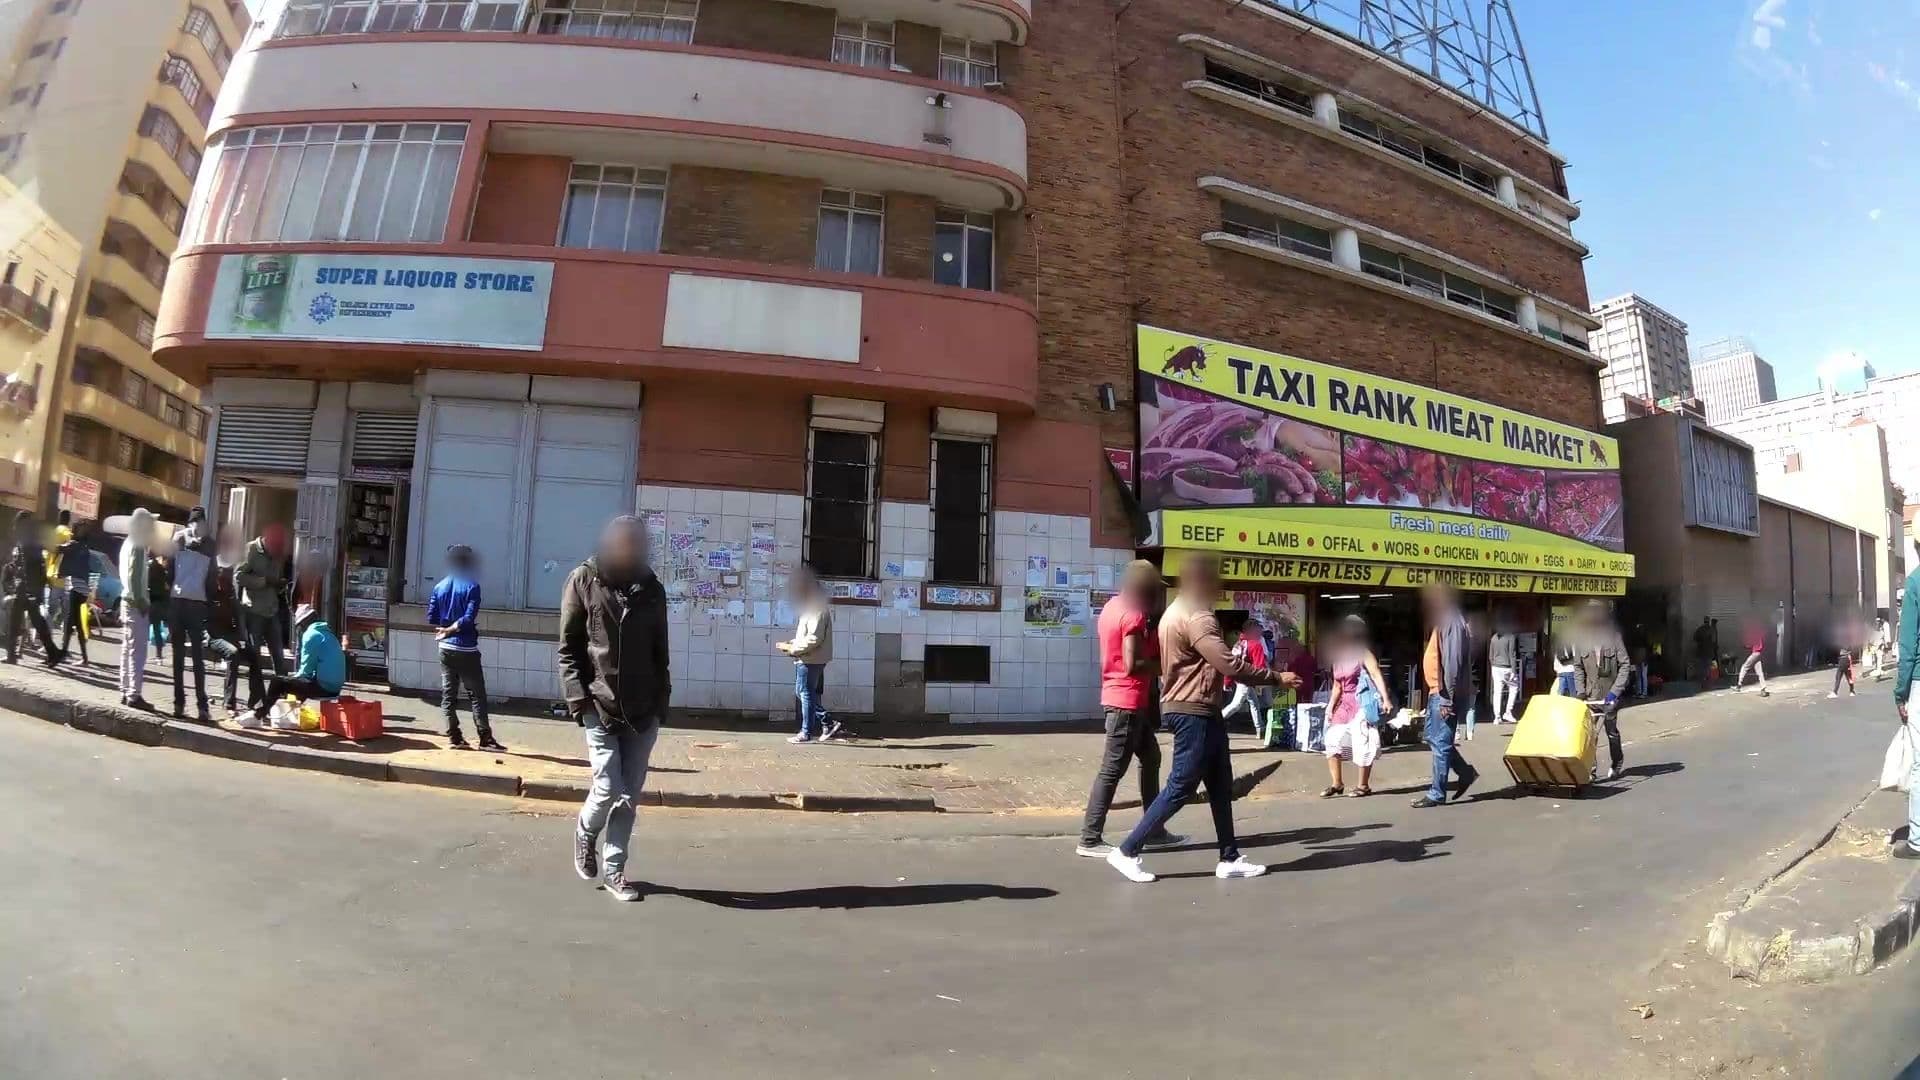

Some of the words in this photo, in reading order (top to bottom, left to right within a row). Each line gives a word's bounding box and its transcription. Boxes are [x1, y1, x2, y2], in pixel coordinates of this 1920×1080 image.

[248, 272, 283, 289] LITE
[315, 268, 378, 285] SUPER
[384, 269, 457, 288] LIQUOR
[464, 272, 535, 292] STORE
[1228, 358, 1316, 408] TAXI
[1329, 379, 1418, 427] RANK
[1426, 401, 1494, 443] MEAT
[1502, 420, 1583, 464] MARKET
[1390, 512, 1434, 532] Fresh
[1440, 519, 1474, 536] meat
[1478, 525, 1510, 542] daily
[1182, 525, 1225, 542] BEEF
[1257, 531, 1299, 548] LAMB
[1322, 536, 1364, 553] OFFAL
[1384, 540, 1419, 557] WORS
[1434, 545, 1479, 561] CHICKEN
[1493, 550, 1529, 565] POLONY
[1543, 554, 1565, 568] EGGS
[1577, 557, 1597, 569] DAIRY
[1220, 557, 1242, 575] ET
[1247, 559, 1293, 578] MORE
[1298, 562, 1330, 579] FOR
[1335, 564, 1372, 581] LESS
[1406, 568, 1430, 584] GET
[1435, 570, 1466, 586] MORE
[1470, 572, 1490, 588] FOR
[1494, 574, 1518, 588] LESS
[1542, 578, 1558, 592] GET
[1560, 578, 1584, 592] MORE
[1585, 580, 1599, 592] FOR
[1601, 580, 1617, 593] LESS
